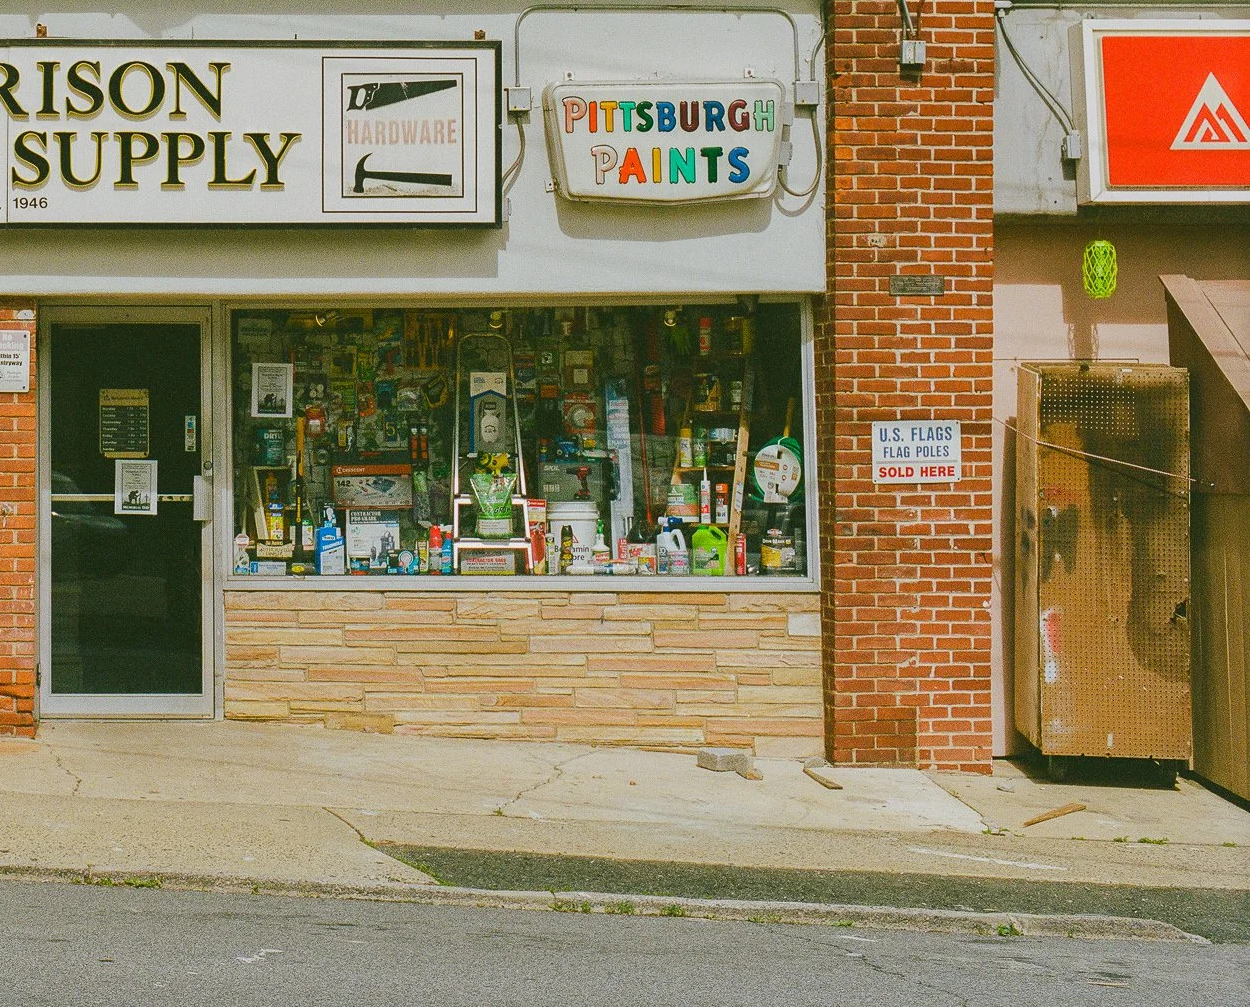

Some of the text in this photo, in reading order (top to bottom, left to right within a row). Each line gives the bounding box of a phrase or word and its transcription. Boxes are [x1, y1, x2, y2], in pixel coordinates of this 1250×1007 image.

[562, 96, 775, 133] PITTSBURGH
[346, 118, 457, 145] HARDWARE
[12, 130, 303, 192] SUPPLY
[591, 144, 751, 184] PAINTS
[12, 197, 49, 209] 1946
[879, 426, 953, 442] U.S. FLAGS
[883, 445, 949, 458] FLAG POLES
[879, 465, 955, 478] SOLD HERE
[554, 545, 590, 553] Bamin
